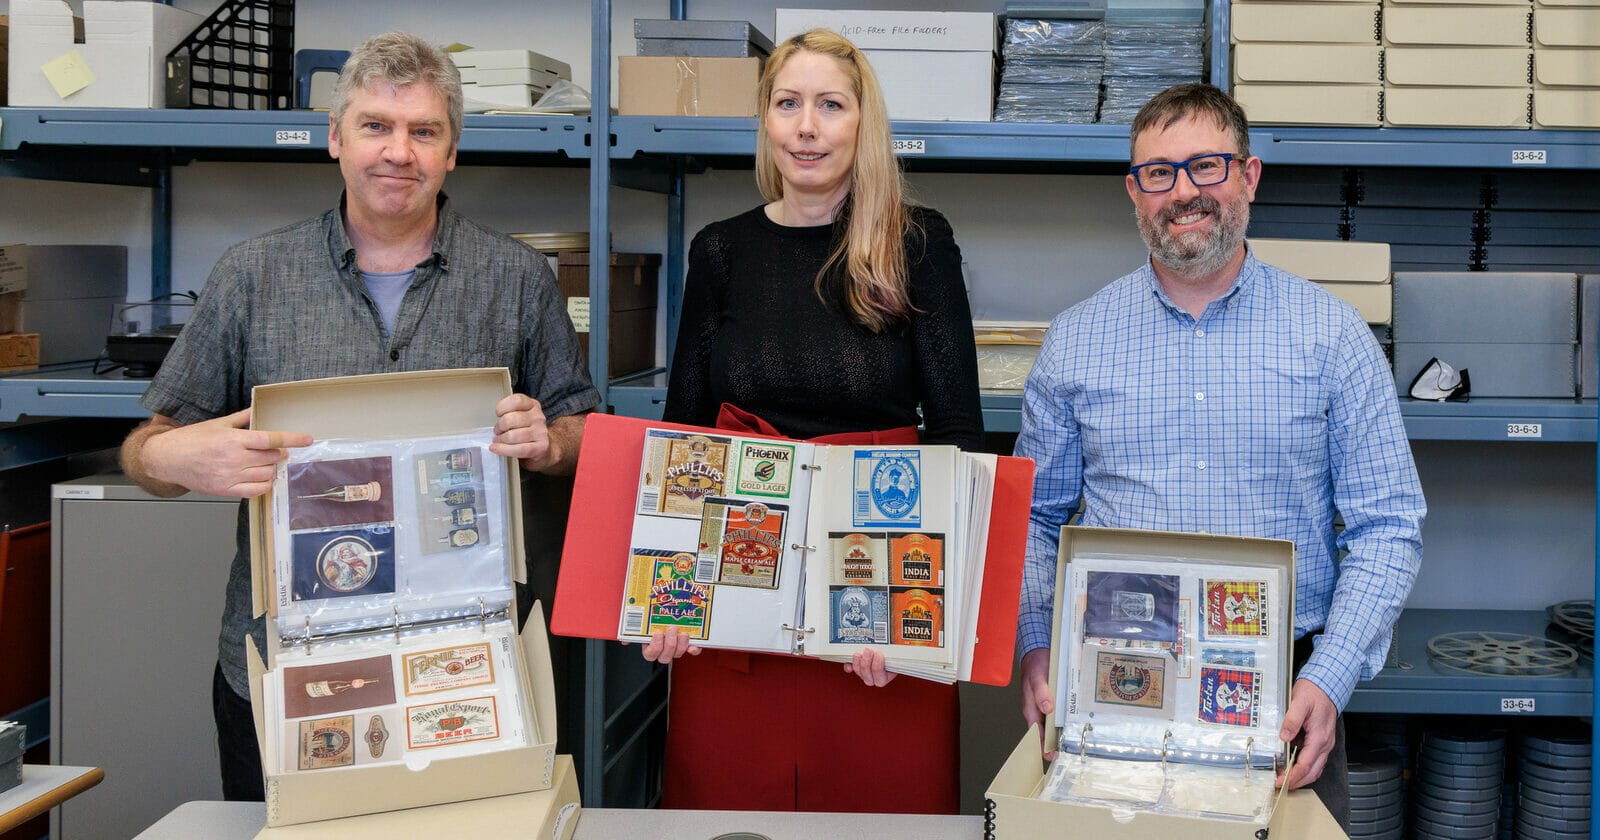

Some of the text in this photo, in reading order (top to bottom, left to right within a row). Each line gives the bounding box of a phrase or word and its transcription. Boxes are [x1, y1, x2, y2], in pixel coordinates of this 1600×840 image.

[277, 132, 308, 141] 33-4-2
[893, 141, 923, 150] 33-5-2
[1513, 151, 1544, 161] 33-6-2
[1508, 425, 1538, 434] 33-6-3
[745, 446, 789, 461] PHOENIX
[667, 462, 724, 482] PHILLIPS
[741, 482, 786, 492] GOLD LAGER
[724, 528, 781, 549] PHILLIPS
[904, 567, 929, 577] INDIA
[652, 580, 709, 599] PHILLIPS
[659, 607, 696, 617] PALE ALE
[1211, 591, 1222, 627] Tartan
[904, 626, 931, 636] INDIA
[465, 653, 487, 666] BEER
[408, 651, 456, 683] FERNIE
[1203, 677, 1214, 714] Tartan
[1503, 700, 1533, 709] 33-6-4
[435, 728, 472, 739] BEER
